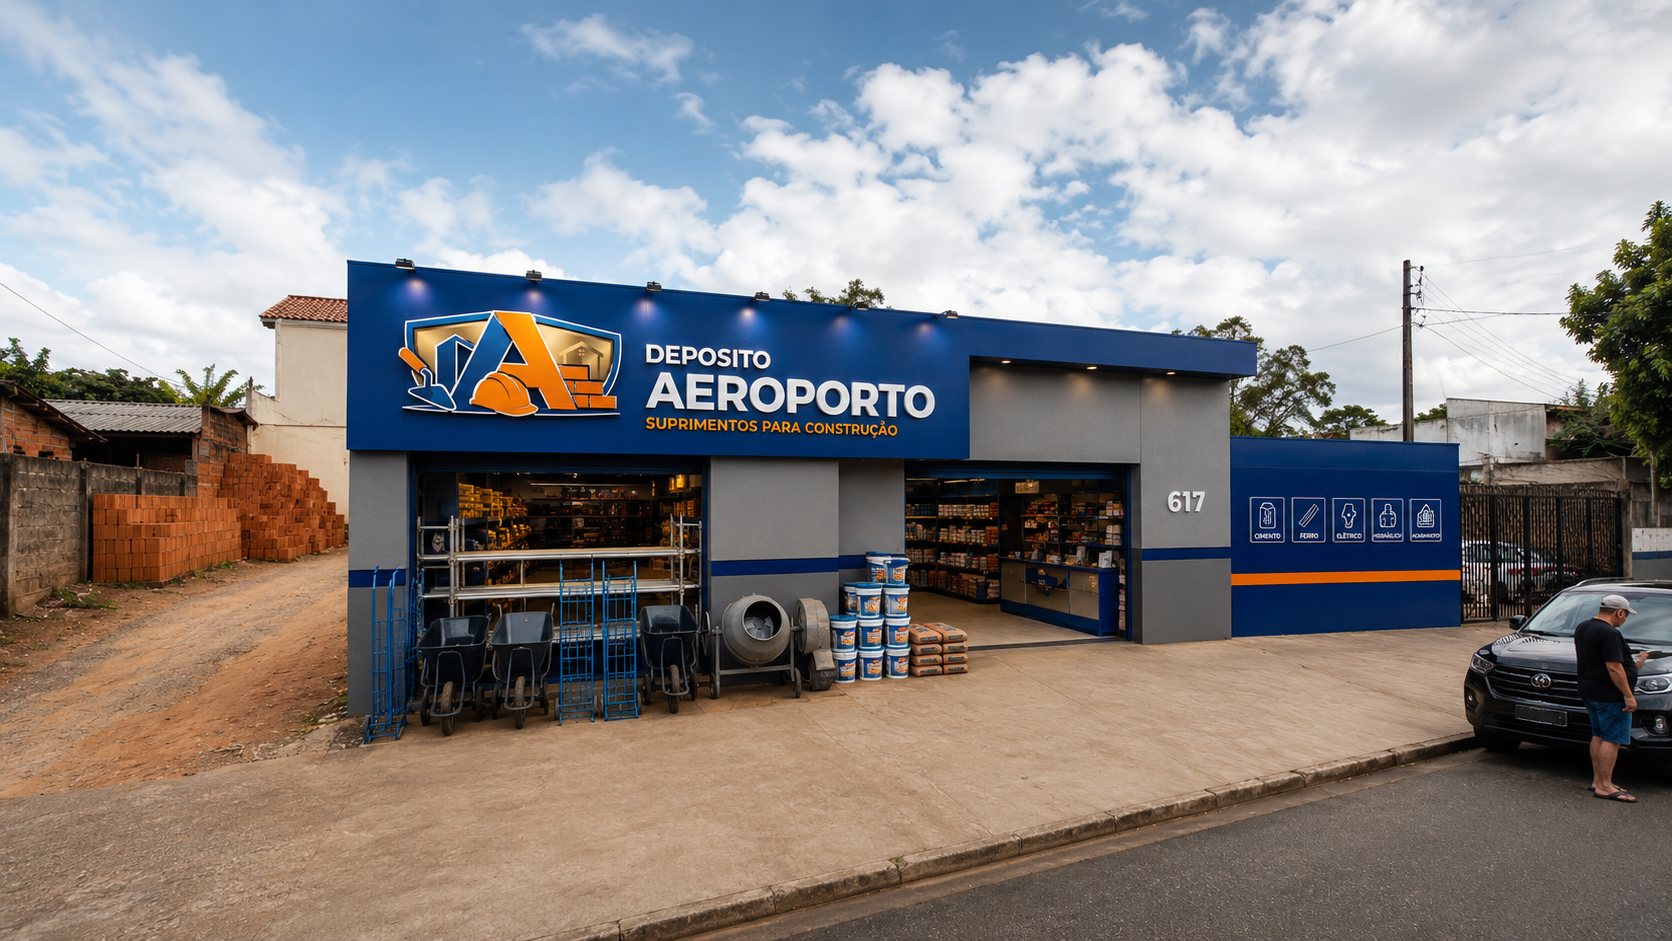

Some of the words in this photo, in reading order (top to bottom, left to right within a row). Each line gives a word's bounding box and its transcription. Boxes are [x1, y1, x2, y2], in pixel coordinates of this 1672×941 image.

[645, 344, 771, 369] DEPOSITO
[645, 372, 936, 418] AEROPORTO
[645, 417, 758, 433] SUPRIMENTOS
[762, 421, 801, 434] PARA
[1167, 490, 1206, 512] 617
